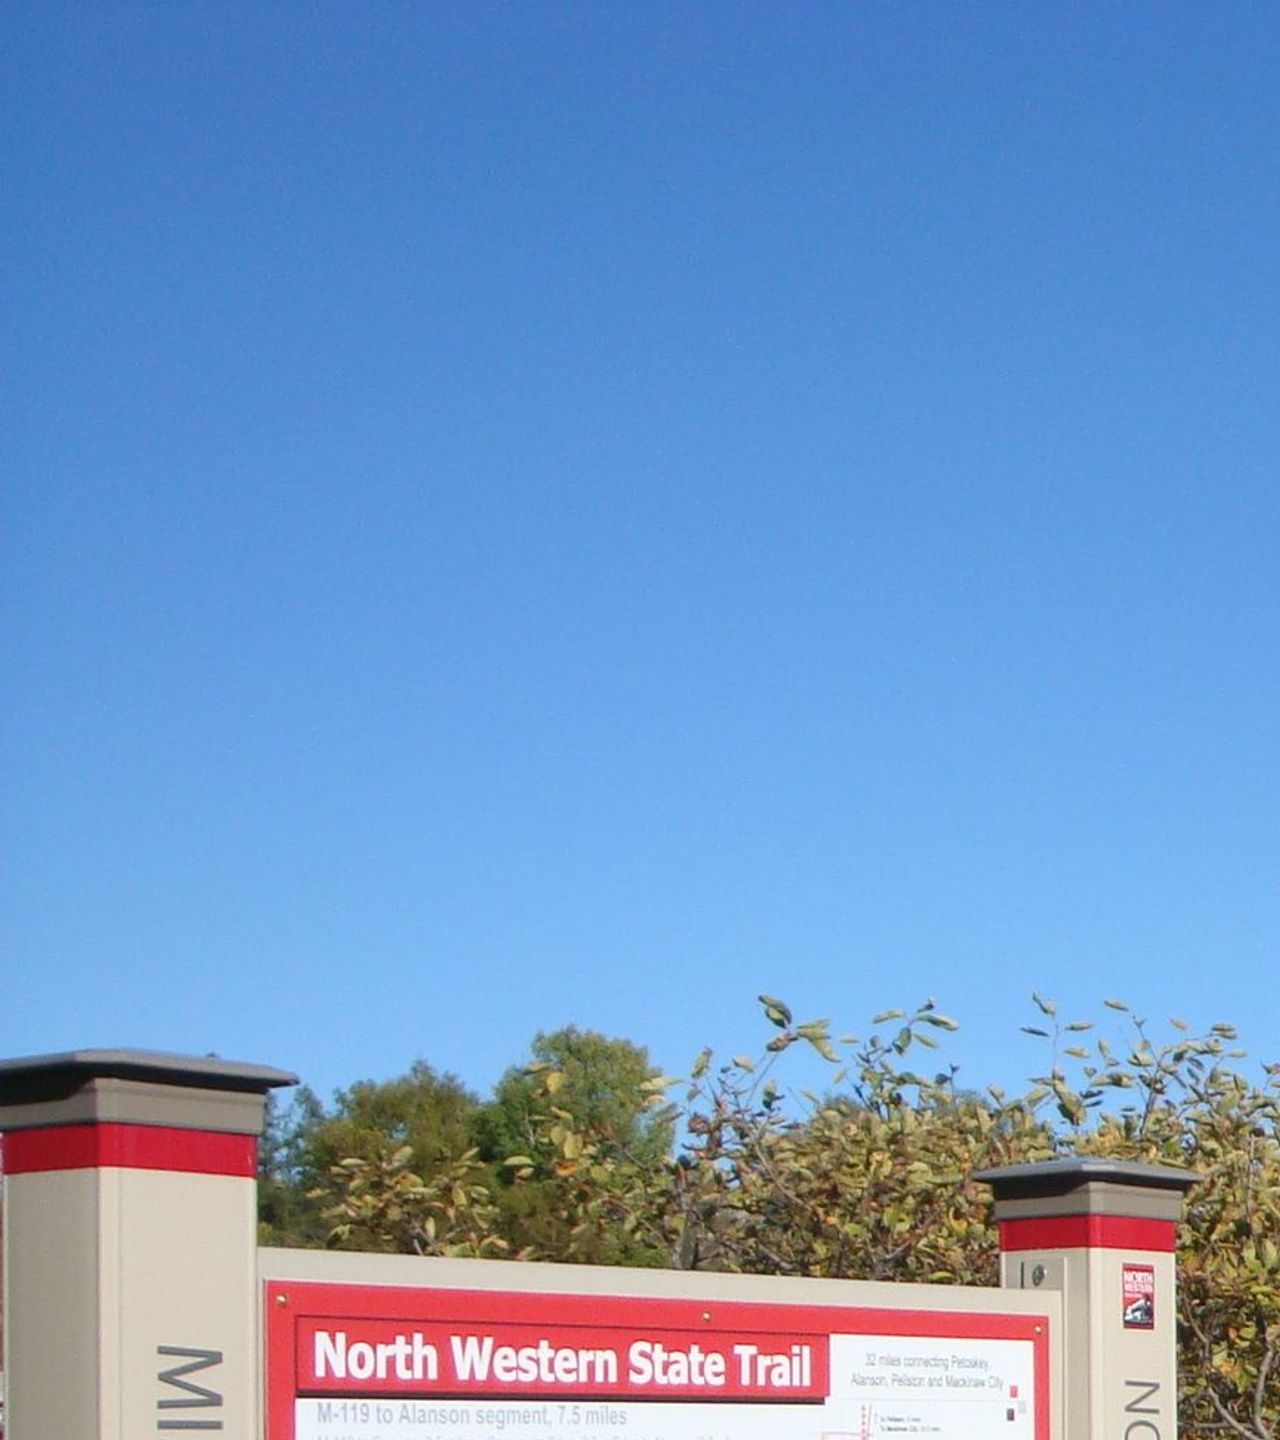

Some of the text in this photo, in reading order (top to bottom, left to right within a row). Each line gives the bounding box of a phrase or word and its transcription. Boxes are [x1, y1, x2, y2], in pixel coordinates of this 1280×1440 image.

[314, 1332, 811, 1388] North Western State Trail
[317, 1402, 628, 1430] M-119 to Alanson segment, 7.5 miles
